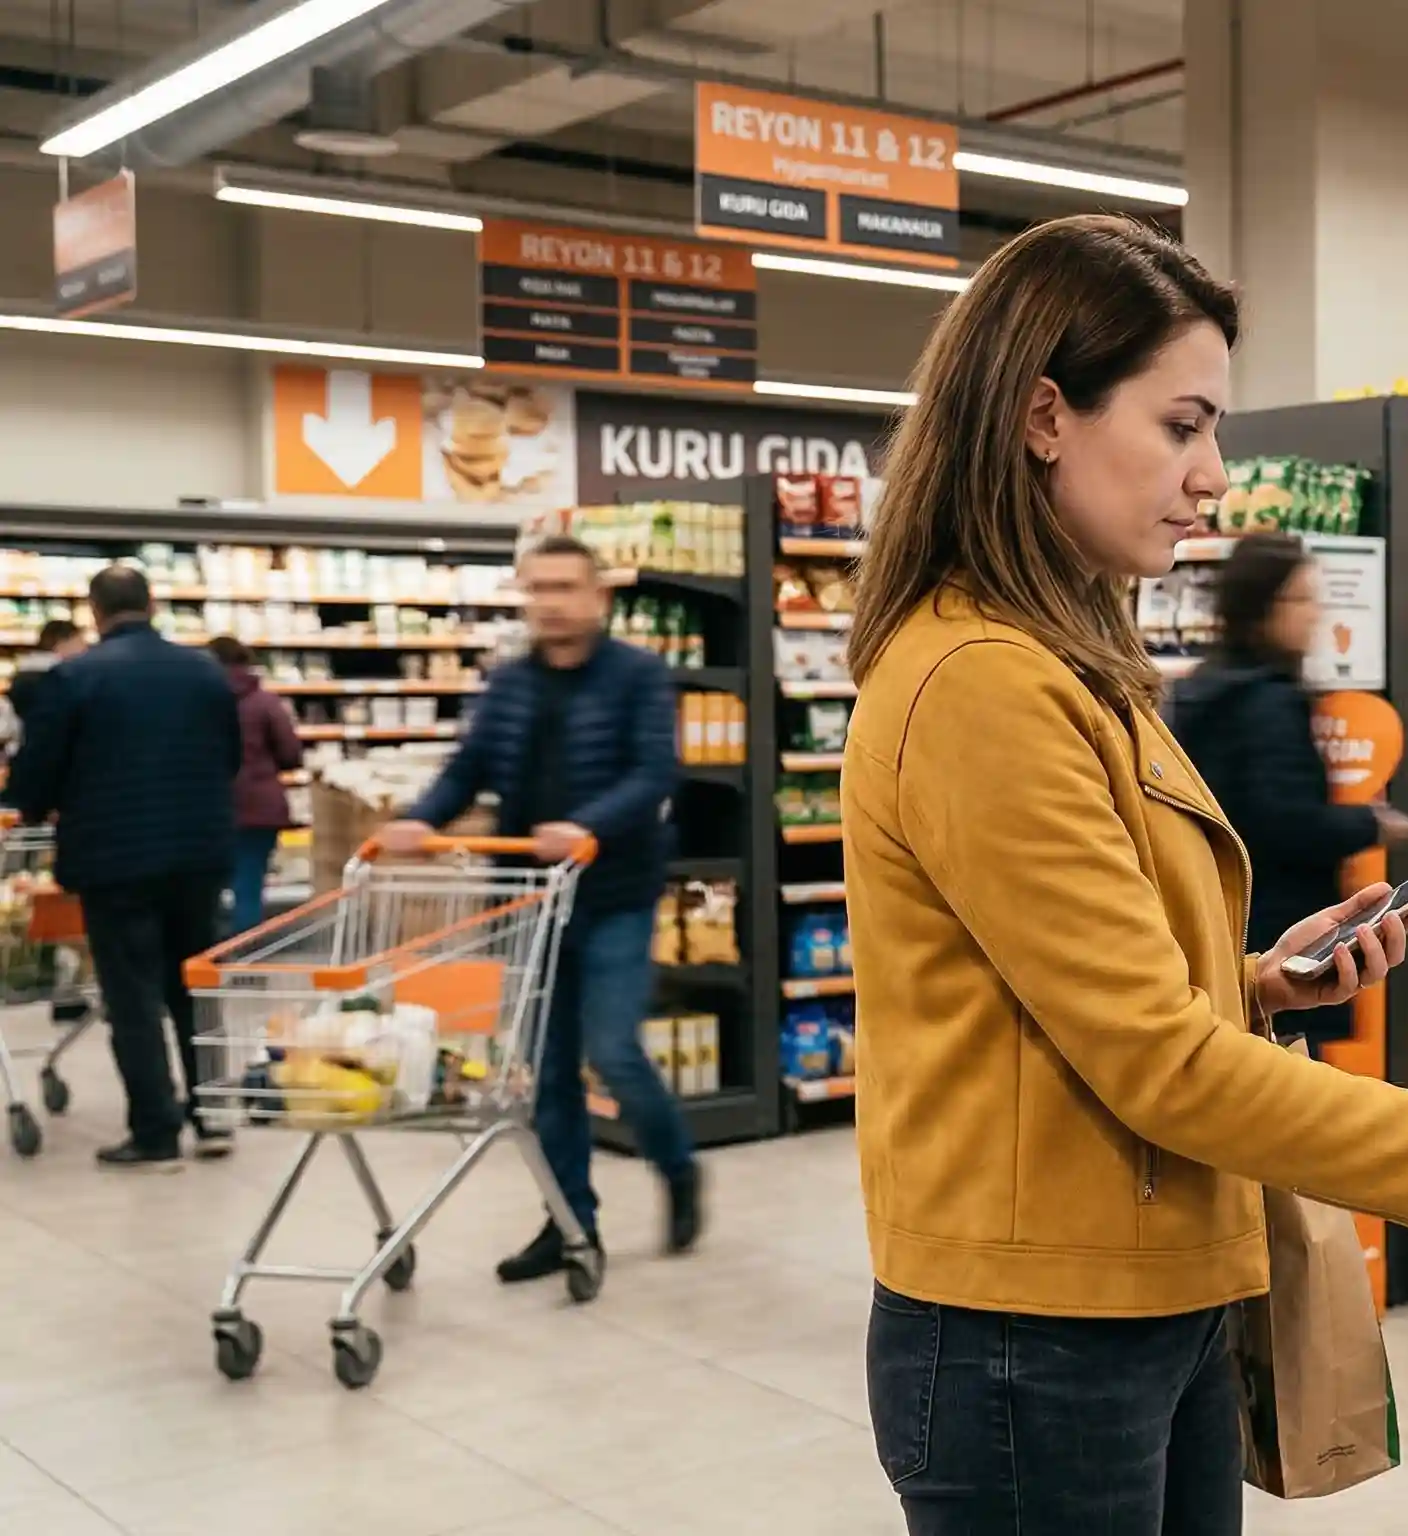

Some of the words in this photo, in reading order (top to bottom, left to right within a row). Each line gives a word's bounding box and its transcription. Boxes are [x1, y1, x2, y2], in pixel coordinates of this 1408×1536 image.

[711, 101, 822, 149] REYON
[831, 121, 869, 158] 11
[876, 128, 899, 163] &
[908, 134, 946, 170] 12
[520, 234, 614, 269] REYON
[622, 246, 656, 275] 11
[689, 254, 723, 282] 12
[601, 423, 744, 480] KURU
